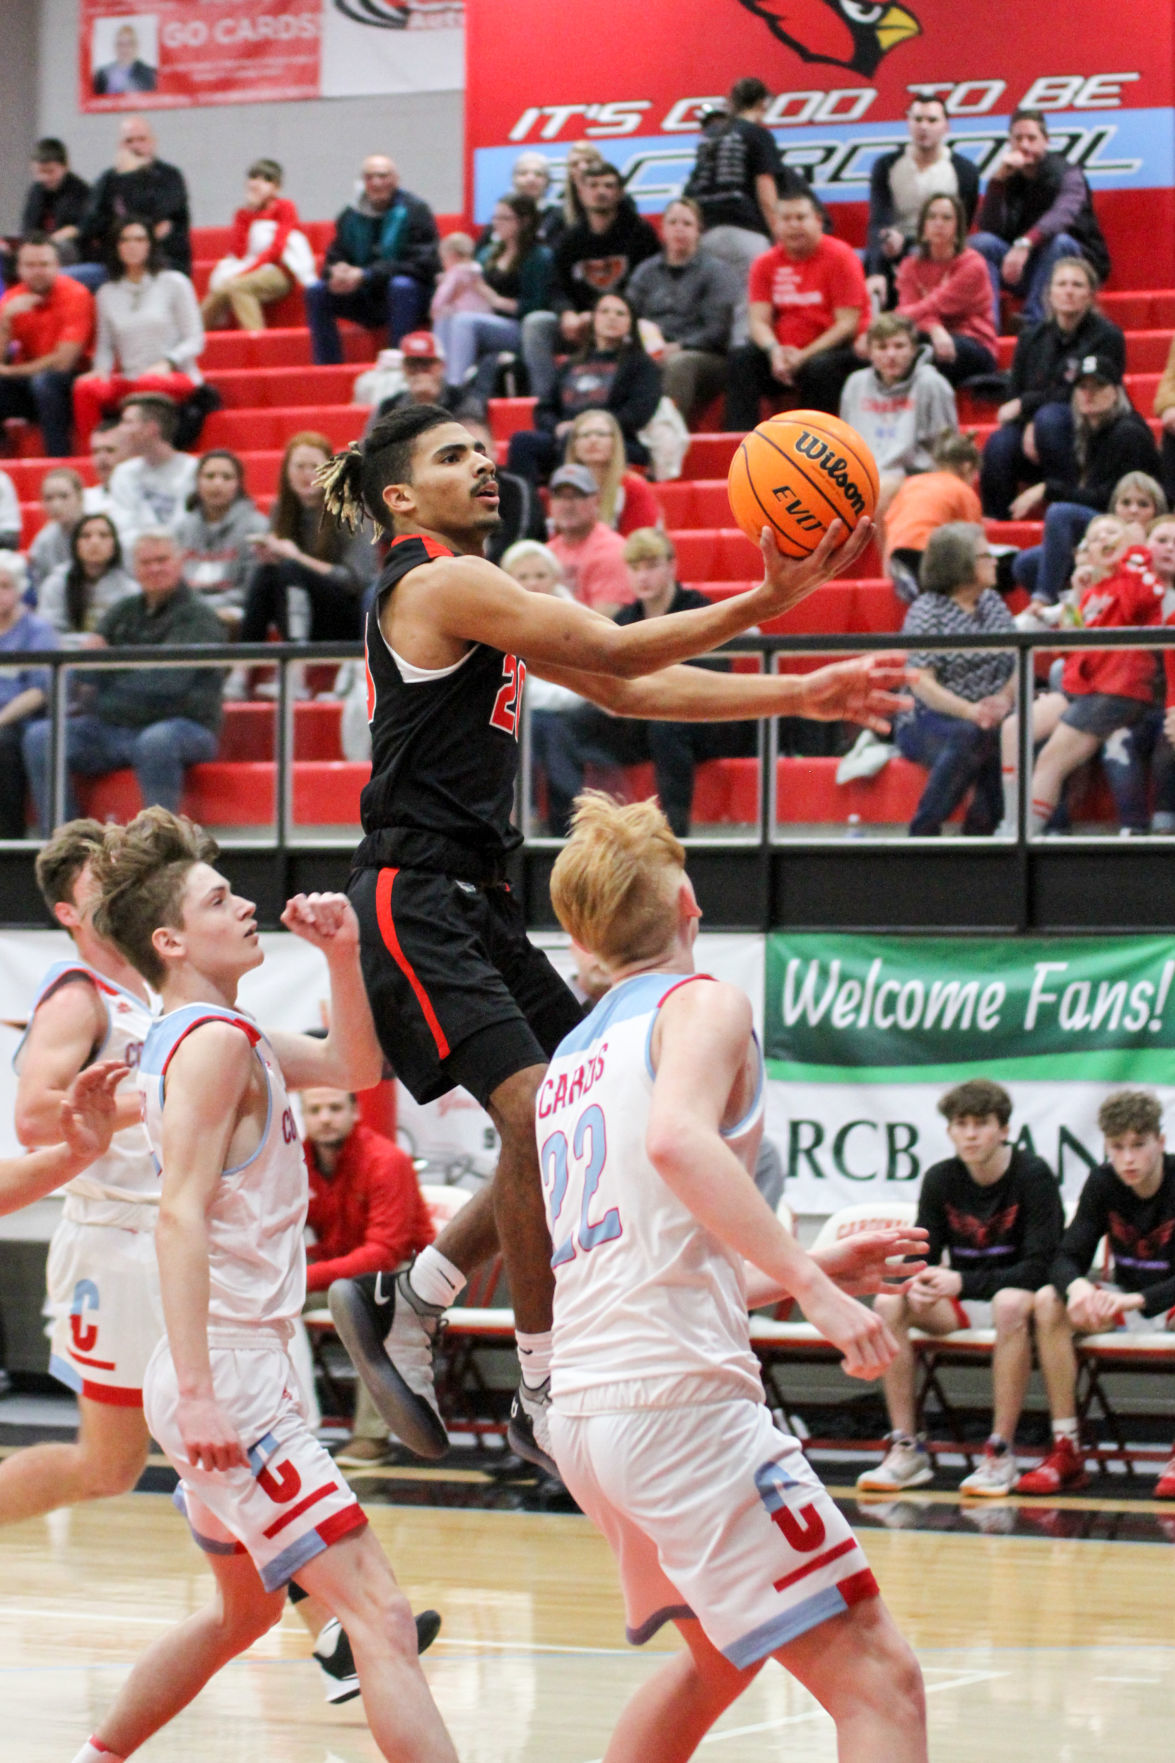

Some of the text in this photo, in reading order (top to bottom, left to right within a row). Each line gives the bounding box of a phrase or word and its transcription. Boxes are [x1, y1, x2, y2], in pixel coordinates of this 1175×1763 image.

[162, 21, 208, 47] GO
[508, 99, 652, 141] IT'S
[660, 87, 878, 131] GOD
[1019, 71, 1141, 111] BE
[794, 430, 866, 517] Wilson
[782, 958, 1175, 1032] Welcome Fans!
[538, 1043, 608, 1119] CARDS
[541, 1103, 623, 1269] 22
[786, 1119, 921, 1183] RCB
